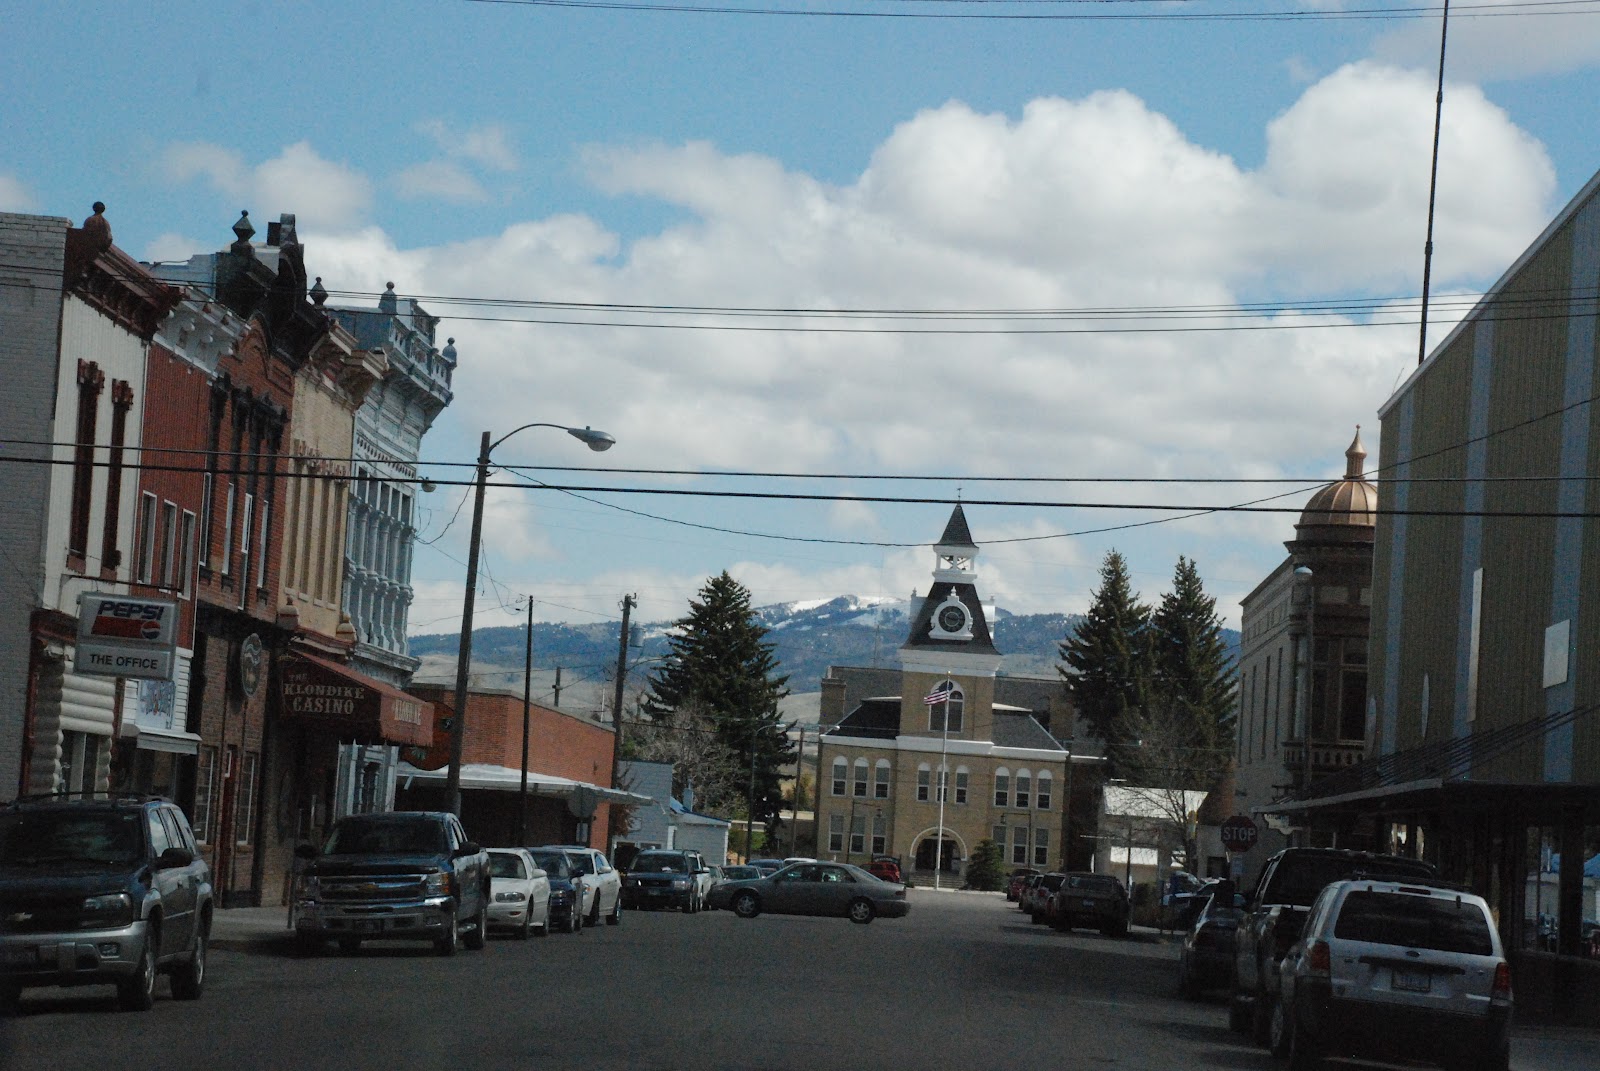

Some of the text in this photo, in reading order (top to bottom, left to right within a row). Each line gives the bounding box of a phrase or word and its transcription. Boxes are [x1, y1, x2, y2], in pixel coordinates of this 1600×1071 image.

[98, 600, 165, 620] PEPSI
[89, 653, 158, 670] THE OFFICE
[288, 673, 308, 682] THE
[284, 683, 365, 700] KLONDIKE
[292, 696, 355, 715] CASINO
[1223, 826, 1256, 841] STOP
